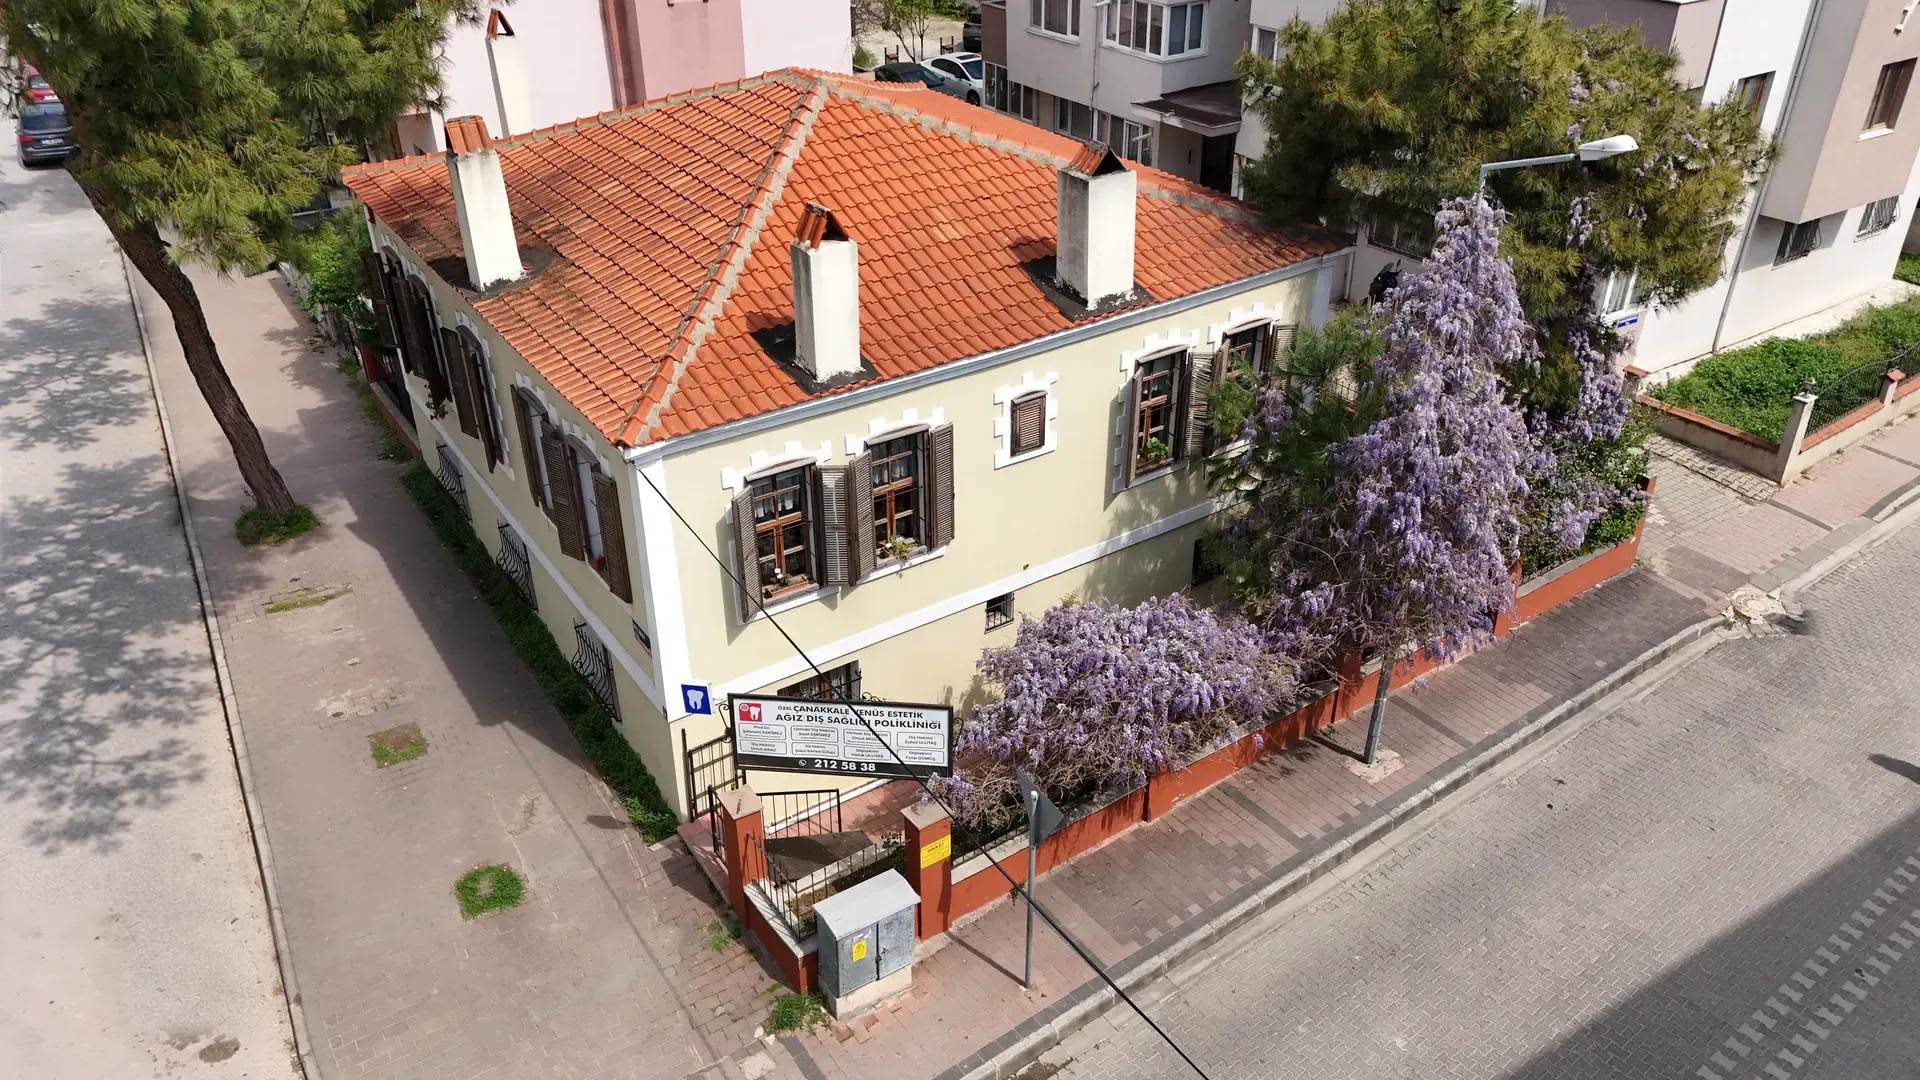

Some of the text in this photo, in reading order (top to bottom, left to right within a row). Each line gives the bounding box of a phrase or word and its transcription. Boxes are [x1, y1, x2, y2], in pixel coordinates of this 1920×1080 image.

[794, 705, 850, 714] ÇANAKKALE
[888, 710, 923, 718] ESTETİK
[776, 713, 803, 722] AĞIZ
[806, 714, 824, 724] DİŞ
[874, 719, 940, 730] POLİKLİNİĞİ
[814, 760, 876, 771] 212 58 38
